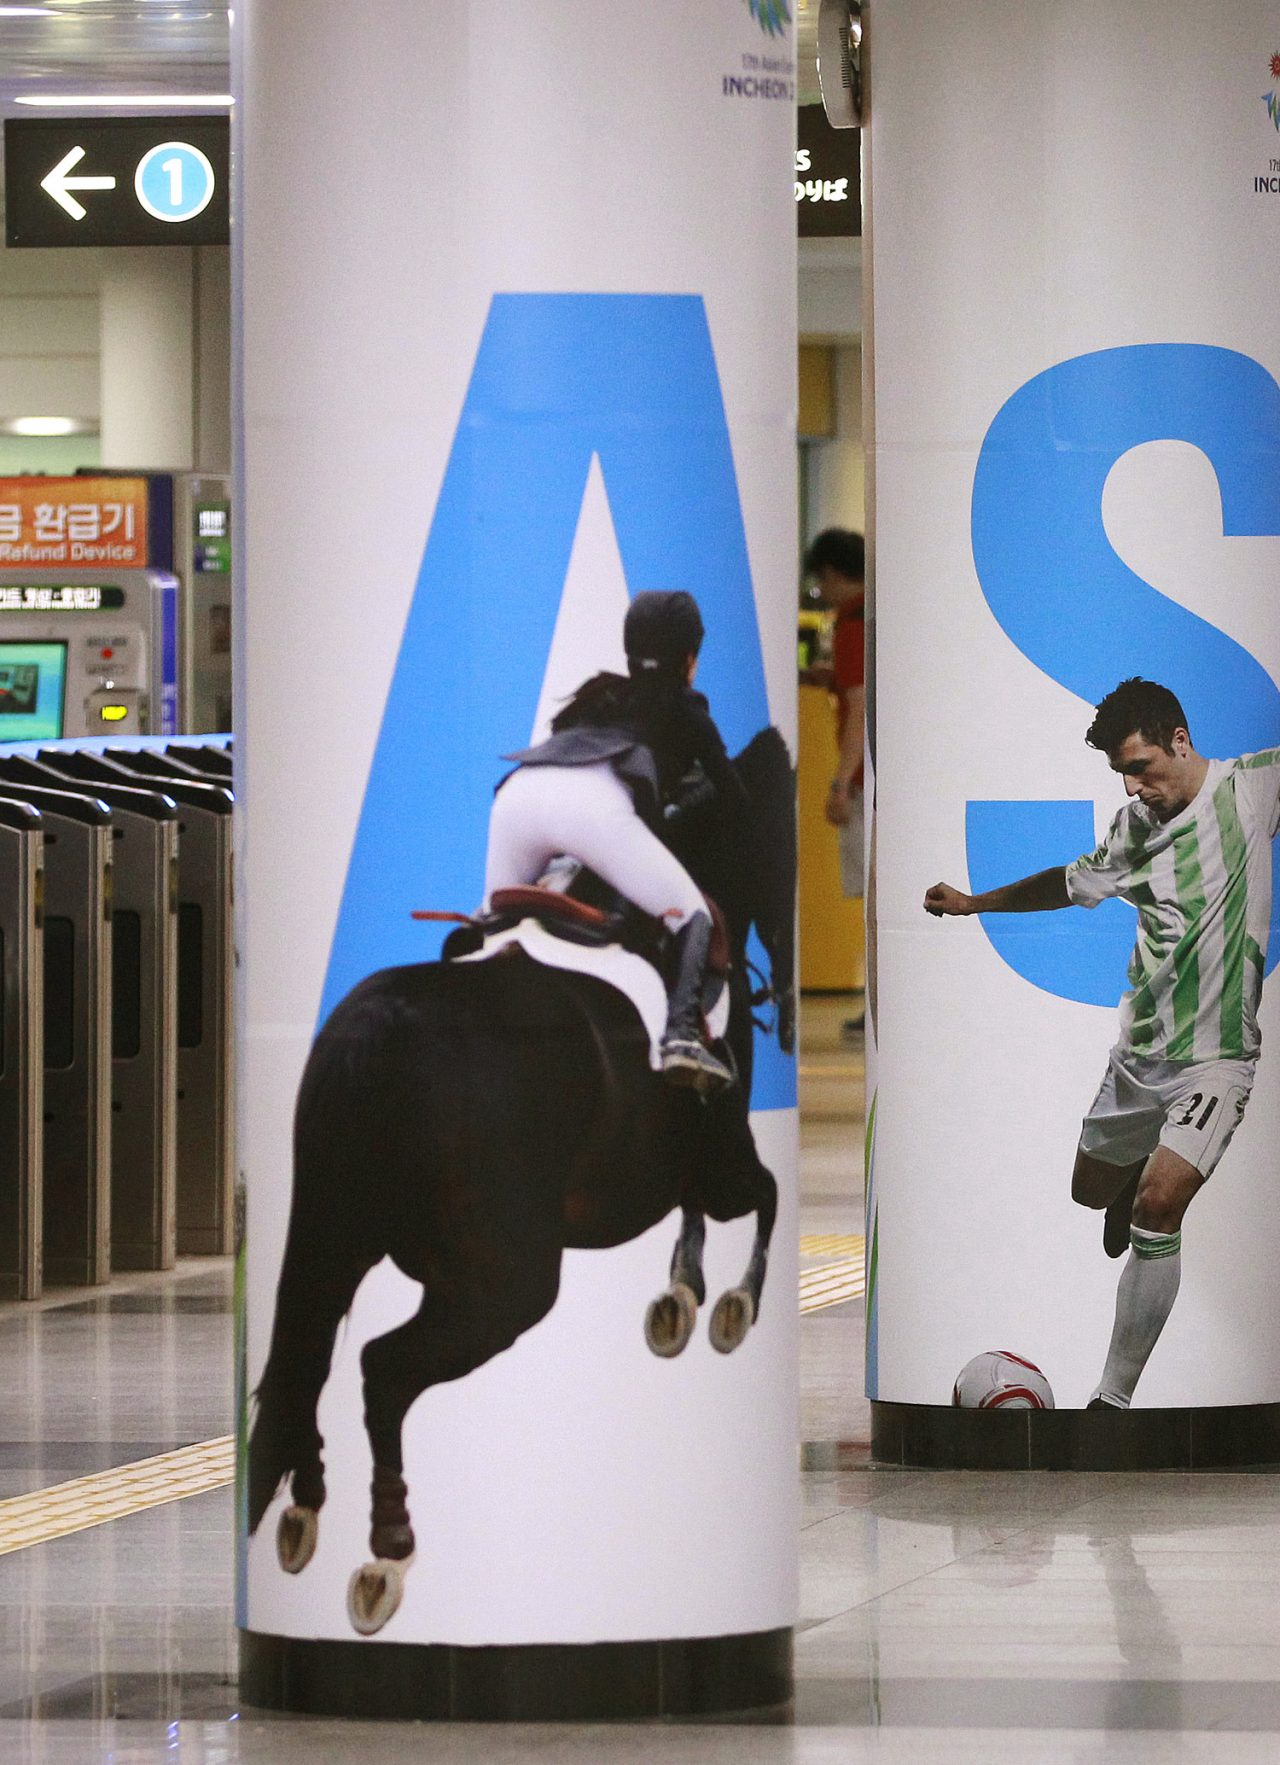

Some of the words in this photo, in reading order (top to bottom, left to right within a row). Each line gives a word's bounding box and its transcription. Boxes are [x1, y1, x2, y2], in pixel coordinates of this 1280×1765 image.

[161, 157, 183, 207] 1
[33, 502, 135, 541] 환급기
[71, 543, 136, 561] Device
